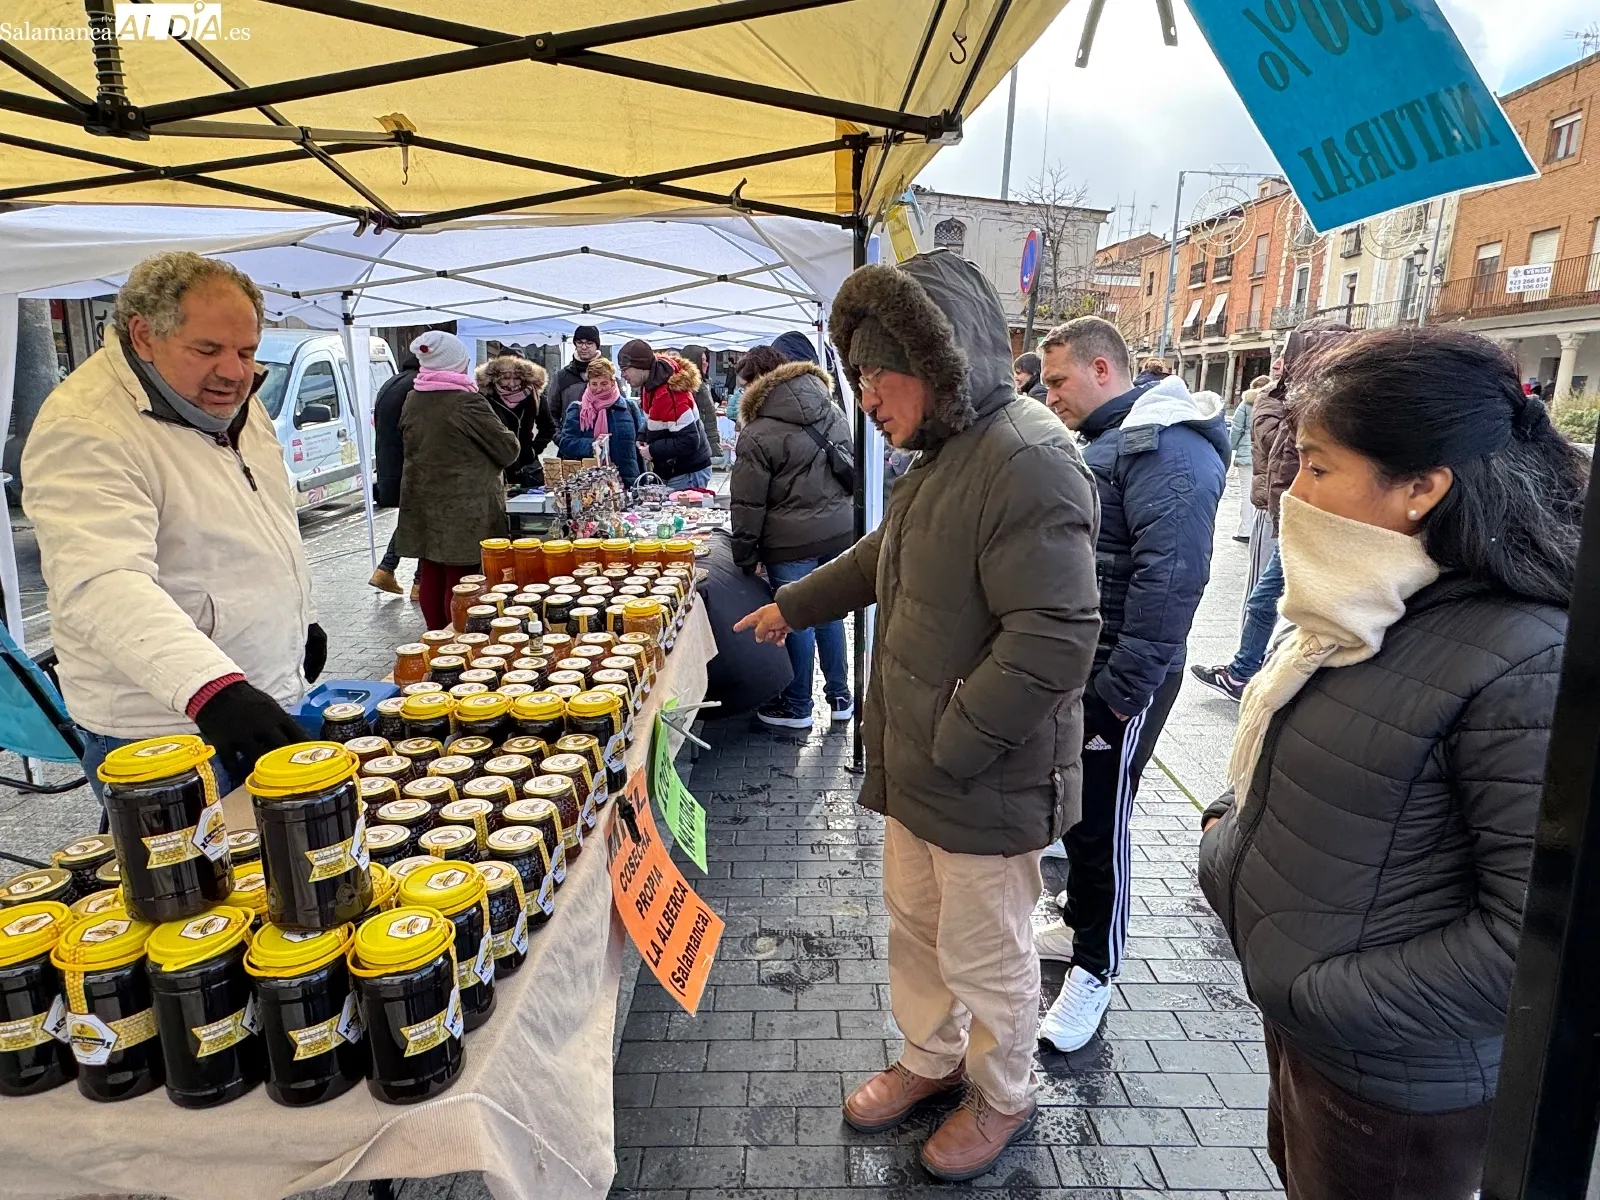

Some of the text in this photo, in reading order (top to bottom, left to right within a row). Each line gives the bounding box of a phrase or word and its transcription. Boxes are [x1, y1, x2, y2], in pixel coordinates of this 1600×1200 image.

[607, 785, 647, 868] MIL
[619, 826, 652, 893] COSECHA
[677, 787, 697, 858] NATURAL
[635, 864, 664, 920] PROPIA
[645, 879, 689, 969] LA ALBERCA
[668, 905, 713, 997] (Salamanca)
